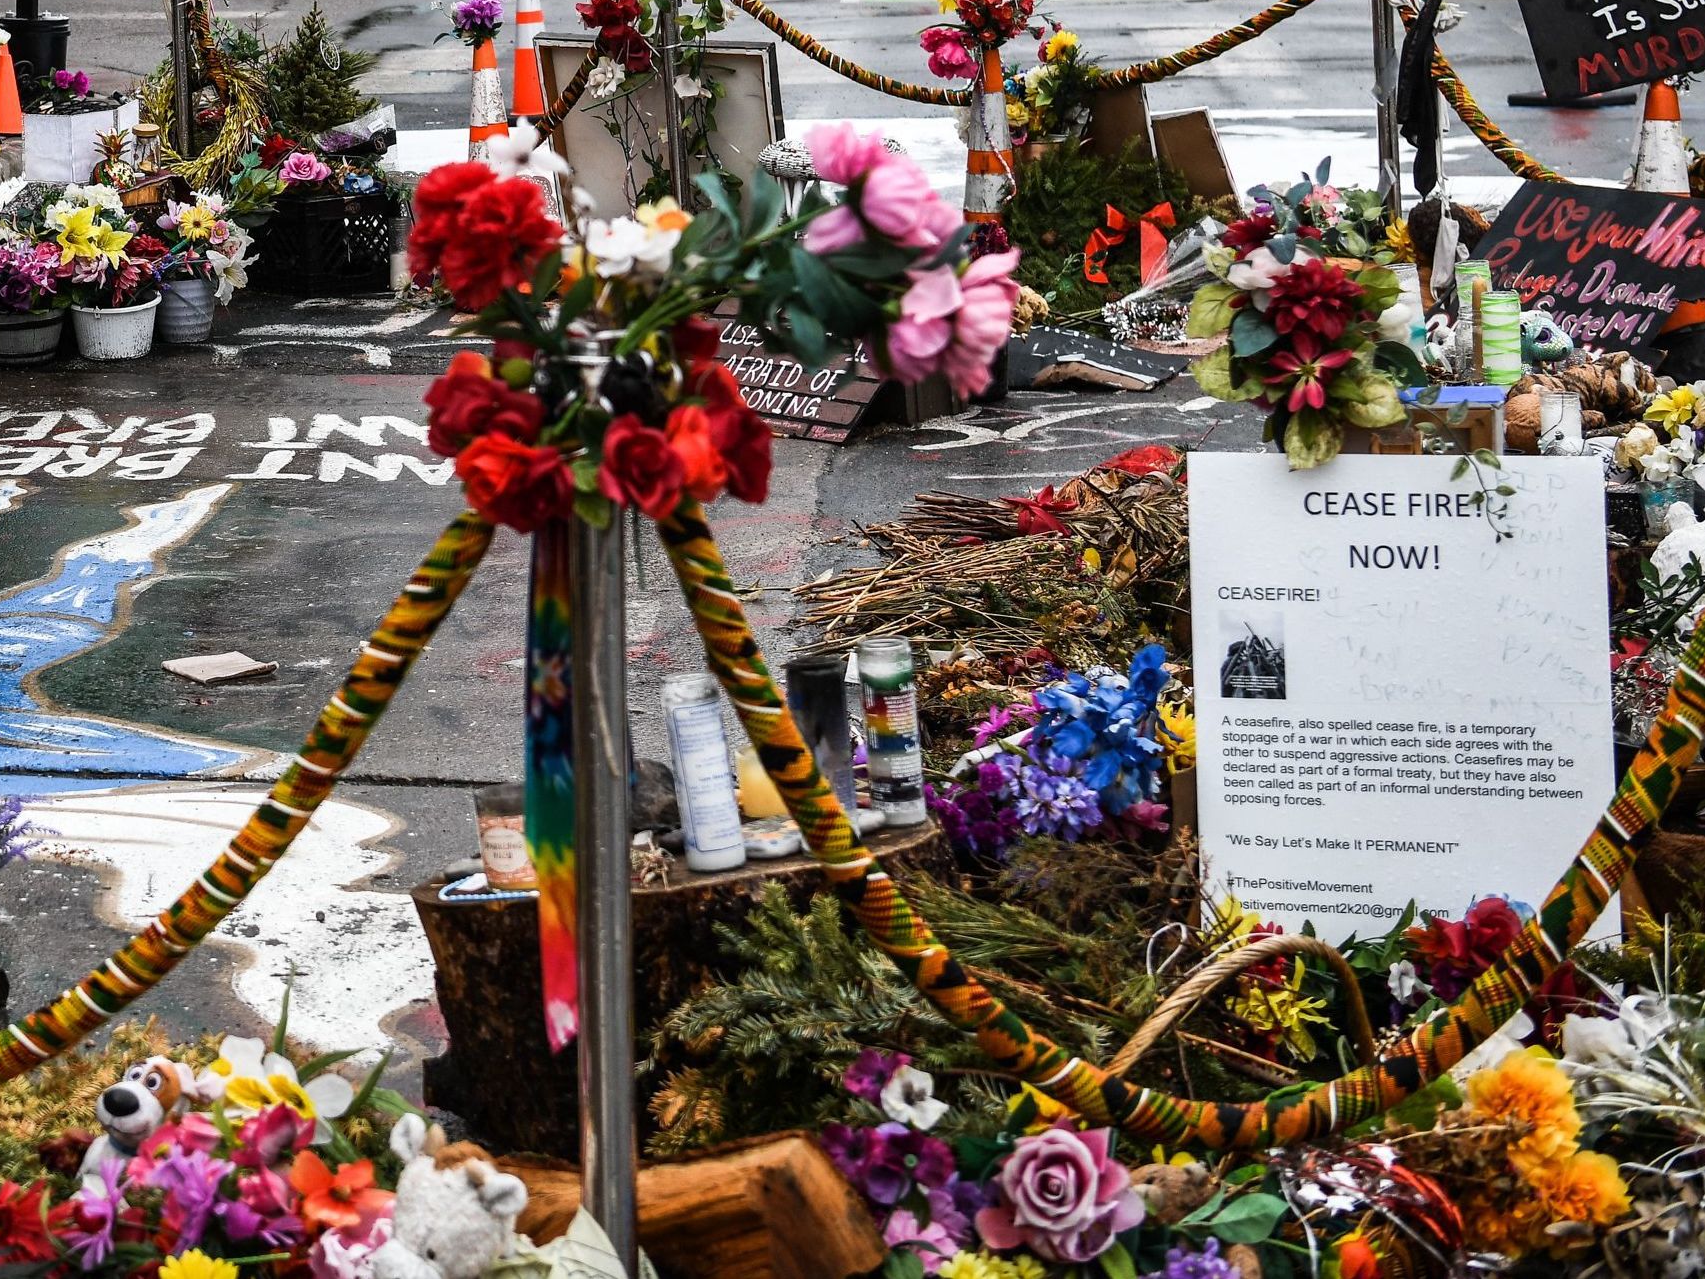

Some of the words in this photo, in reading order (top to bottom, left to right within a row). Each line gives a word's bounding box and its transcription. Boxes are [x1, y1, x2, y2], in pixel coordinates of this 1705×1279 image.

[1592, 3, 1647, 40] Is
[1577, 26, 1705, 93] MURD
[723, 353, 803, 388] AFRAID
[737, 385, 836, 419] SONING."
[1303, 490, 1397, 518] CEASE
[1408, 492, 1483, 519] FIRE!
[1349, 545, 1442, 571] NOW!
[1217, 585, 1321, 603] CEASEFIRE!
[1221, 714, 1232, 726] A
[1234, 715, 1295, 730] ceasefire,
[1297, 718, 1325, 730] also
[1327, 718, 1373, 733] spelled
[1375, 721, 1415, 733] cease
[1416, 720, 1442, 735] fire,
[1445, 723, 1457, 734] is
[1459, 724, 1468, 734] a
[1470, 723, 1537, 739] temporary
[1221, 731, 1279, 746] stoppage
[1281, 731, 1295, 744] of
[1297, 734, 1307, 744] a
[1308, 735, 1333, 746] war
[1335, 735, 1348, 747] in
[1349, 734, 1387, 747] which
[1389, 735, 1422, 749] each
[1424, 736, 1452, 749] side
[1454, 739, 1500, 753] agrees
[1501, 738, 1529, 751] with
[1531, 739, 1554, 752] the
[1222, 746, 1255, 758] other
[1257, 748, 1270, 759] to
[1272, 747, 1327, 762] suspend
[1329, 751, 1398, 766] aggressive
[1401, 752, 1450, 765] actions.
[1453, 752, 1524, 767] Ceasefires
[1525, 756, 1555, 771] may
[1557, 755, 1575, 768] be
[1222, 761, 1277, 774] declared
[1279, 764, 1295, 775] as
[1297, 764, 1324, 778] part
[1325, 763, 1339, 776] of
[1341, 766, 1351, 777] a
[1352, 764, 1393, 778] formal
[1395, 767, 1436, 782] treaty,
[1439, 768, 1461, 781] but
[1462, 768, 1492, 784] they
[1493, 769, 1527, 783] have
[1528, 770, 1557, 784] also
[1223, 777, 1255, 788] been
[1257, 777, 1295, 790] called
[1297, 780, 1314, 791] as
[1316, 780, 1342, 794] part
[1344, 780, 1358, 793] of
[1360, 782, 1377, 793] an
[1379, 781, 1431, 795] informal
[1433, 783, 1525, 801] understanding
[1528, 786, 1584, 800] between
[1223, 793, 1281, 808] opposing
[1283, 795, 1326, 808] forces.
[1226, 834, 1251, 847] "We
[1255, 835, 1279, 850] Say
[1282, 836, 1312, 849] Let's
[1315, 837, 1350, 850] Make
[1354, 838, 1363, 851] It
[1365, 838, 1460, 854] PERMANENT"
[1227, 875, 1373, 894] #ThePositiveMovement
